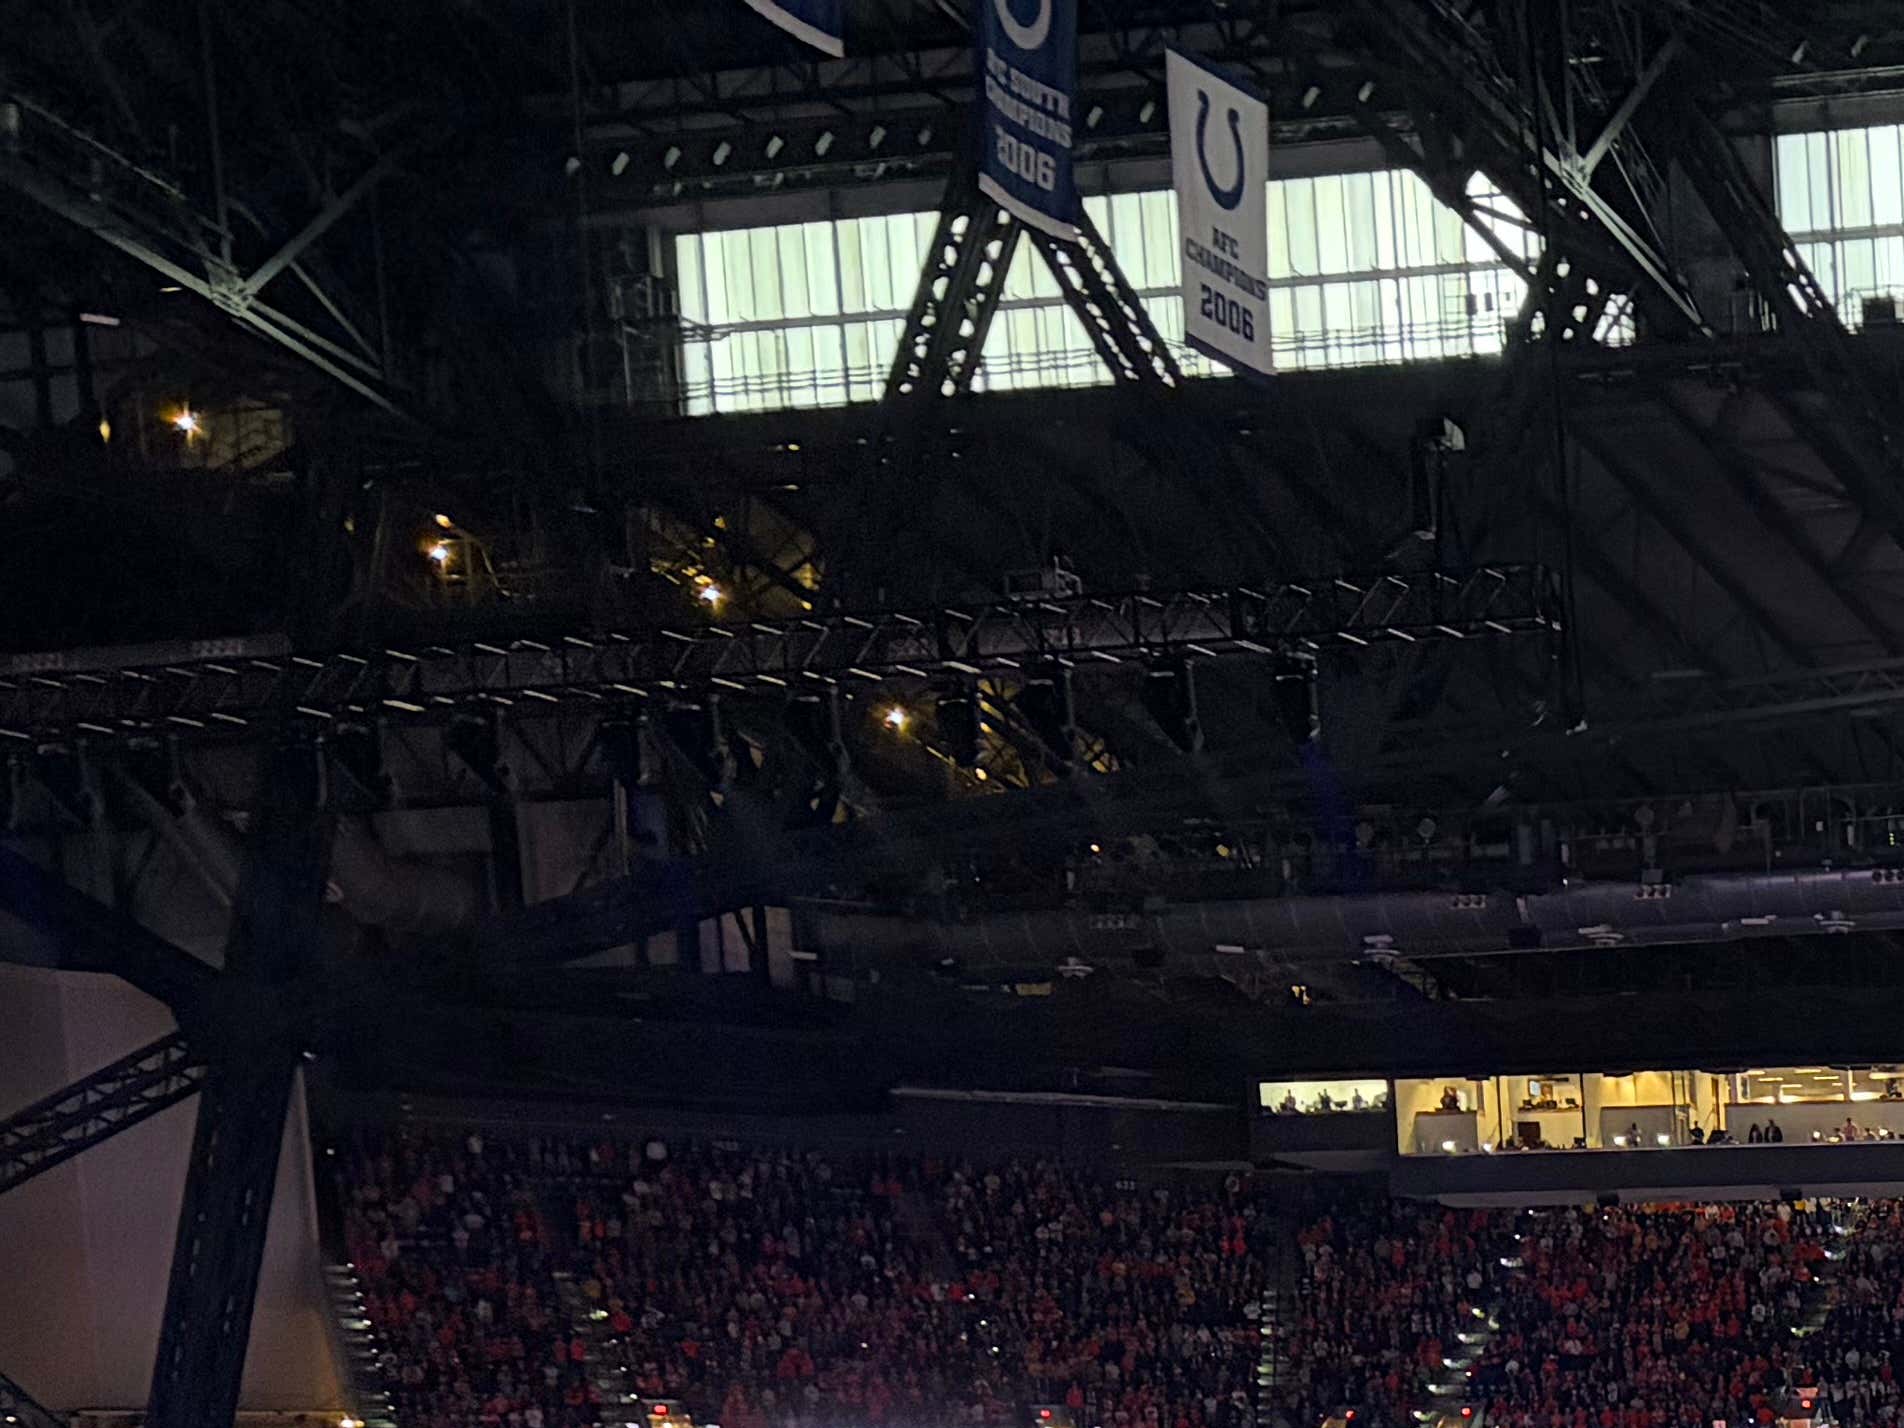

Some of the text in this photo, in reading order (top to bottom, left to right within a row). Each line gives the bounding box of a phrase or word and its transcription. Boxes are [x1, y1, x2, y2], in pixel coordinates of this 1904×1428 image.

[996, 126, 1056, 191] 2006
[1185, 237, 1266, 302] CHAMPIONS
[1212, 228, 1240, 260] AFC
[1200, 284, 1254, 343] 2006
